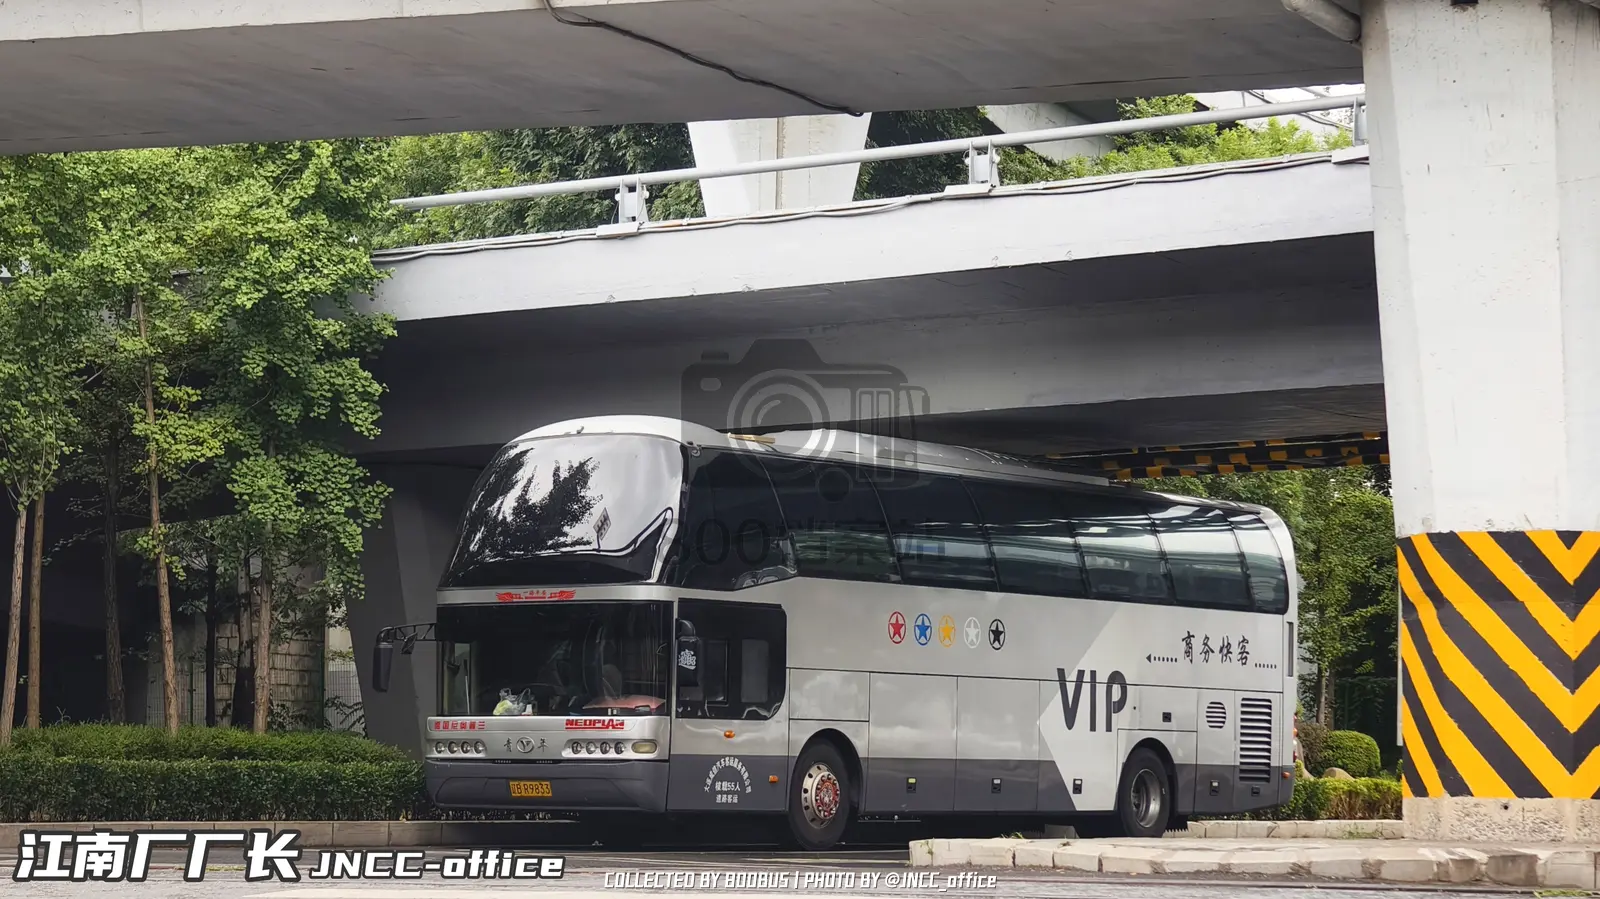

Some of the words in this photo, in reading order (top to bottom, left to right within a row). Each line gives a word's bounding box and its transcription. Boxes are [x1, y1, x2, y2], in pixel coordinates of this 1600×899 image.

[1181, 631, 1250, 666] 商务快客
[1056, 667, 1128, 732] VIP
[565, 719, 625, 730] NEOPLAN
